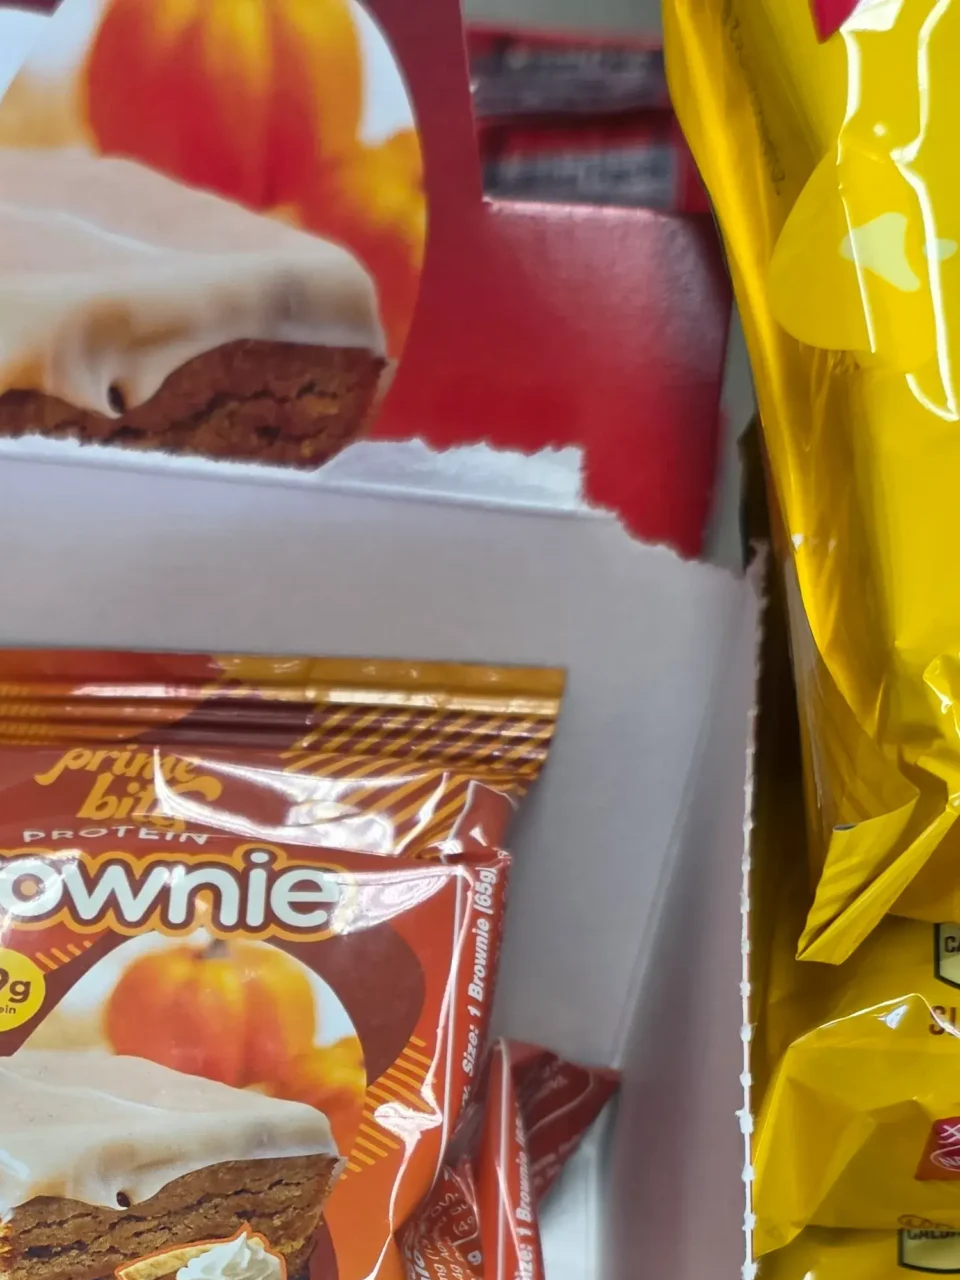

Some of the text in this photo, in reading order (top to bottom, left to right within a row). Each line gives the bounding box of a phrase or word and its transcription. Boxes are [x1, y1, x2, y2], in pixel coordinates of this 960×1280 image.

[23, 825, 209, 845] PROTEIN
[468, 917, 490, 1000] Brownie
[468, 1005, 480, 1016] 1
[461, 1024, 479, 1076] Size:
